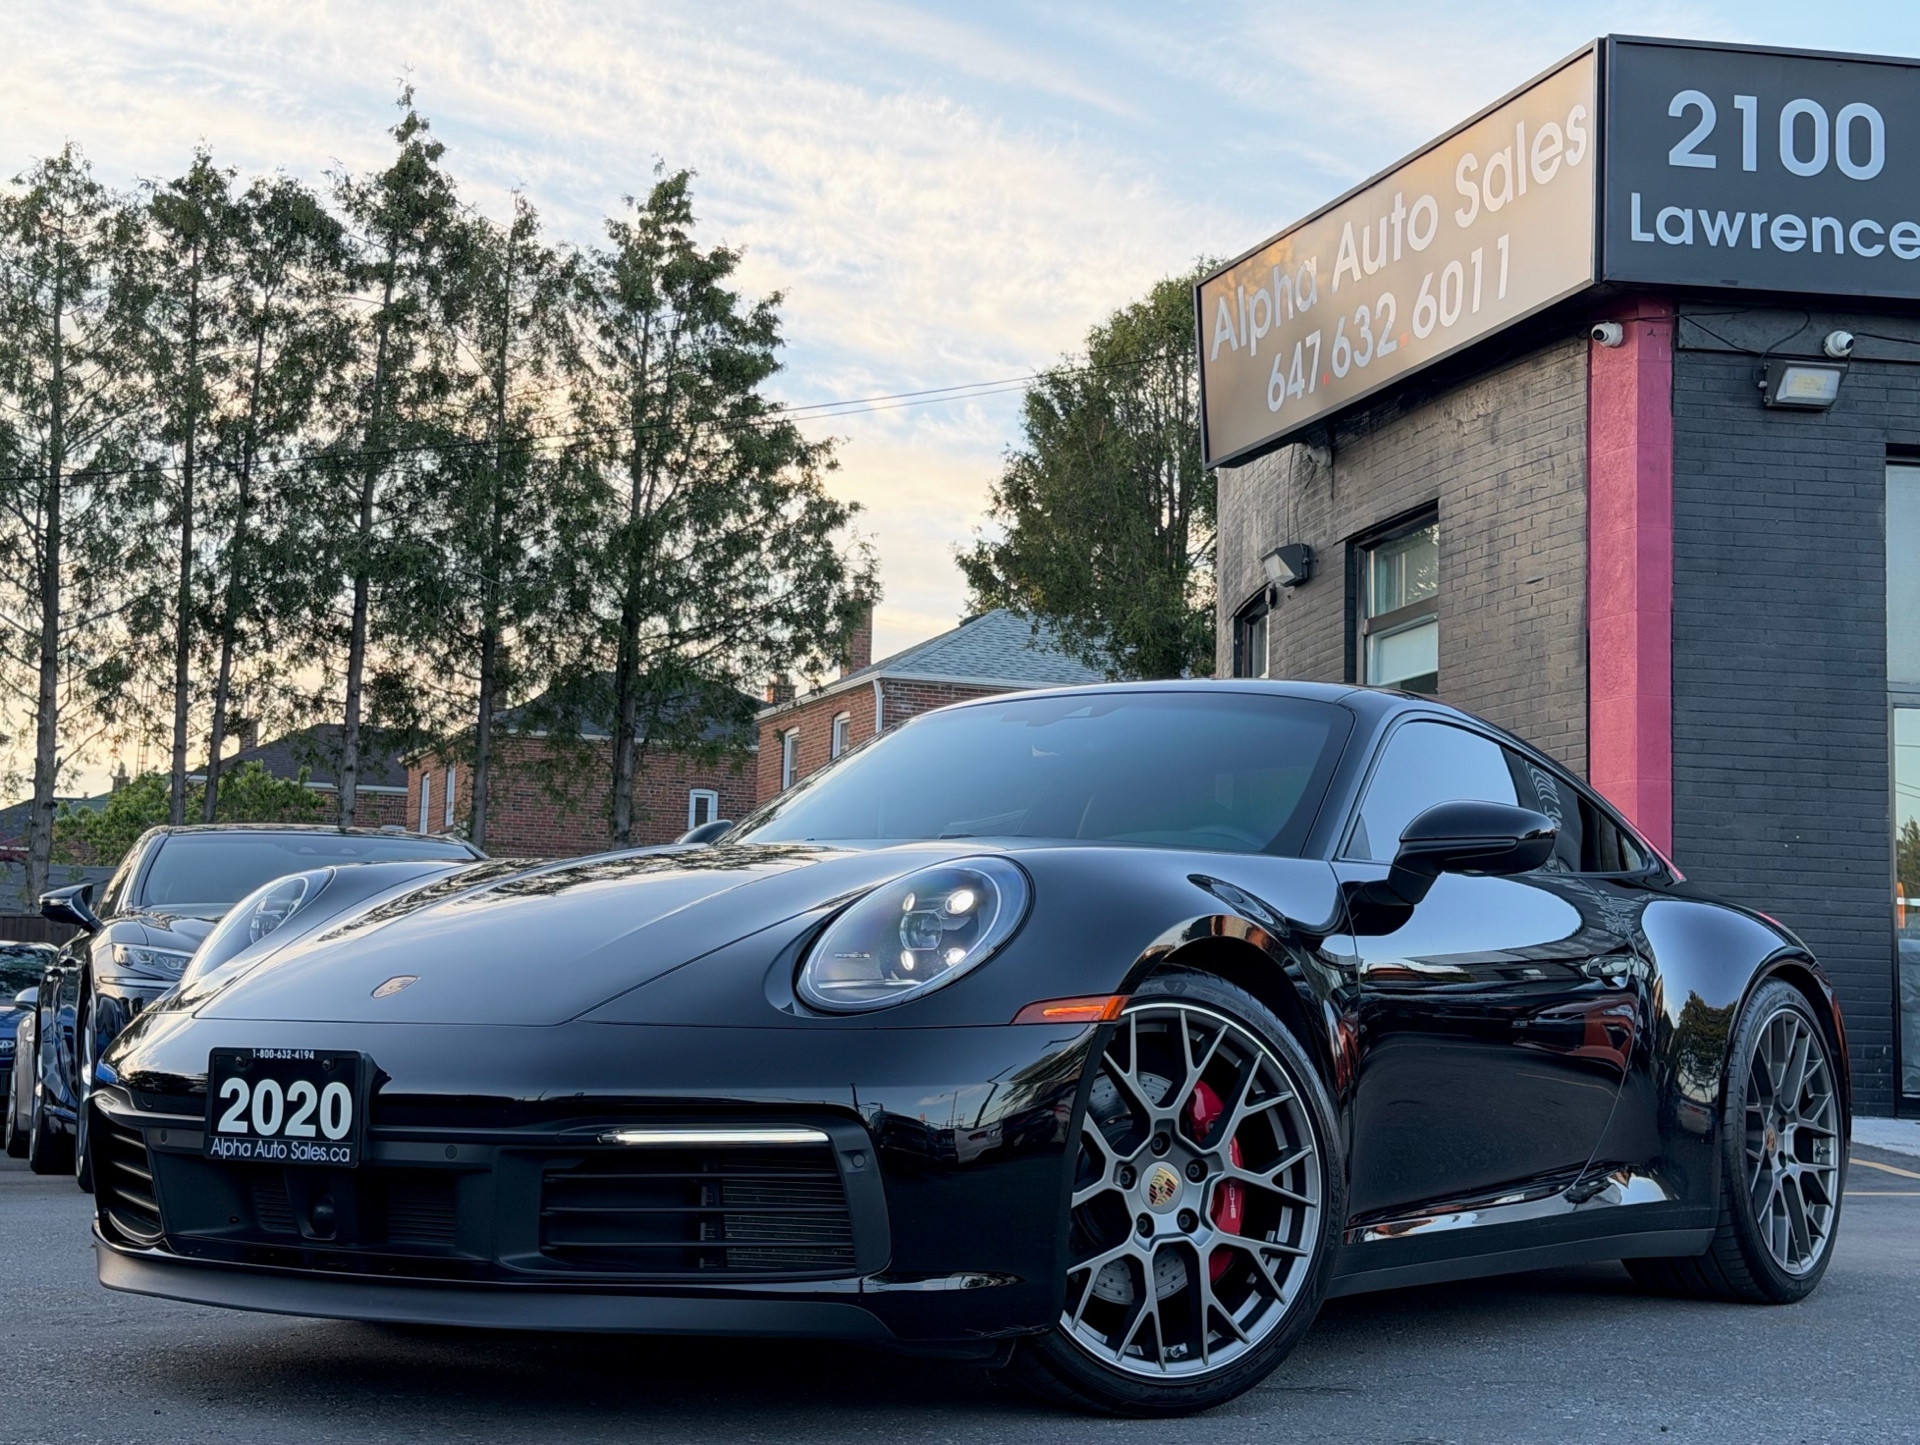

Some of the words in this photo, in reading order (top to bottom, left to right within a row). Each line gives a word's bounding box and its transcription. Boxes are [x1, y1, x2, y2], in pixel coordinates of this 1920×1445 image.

[1667, 89, 1886, 181] 2100
[1210, 255, 1318, 362] Alpha
[1331, 191, 1439, 294] Auto
[1454, 103, 1588, 229] Sales
[1630, 191, 1920, 260] Lawrence
[252, 1048, 315, 1060] 1-800-632-4194
[217, 1077, 353, 1141] 2020
[210, 1137, 251, 1160] Alpha
[253, 1139, 288, 1159] Auto
[290, 1141, 351, 1163] Sales.ca
